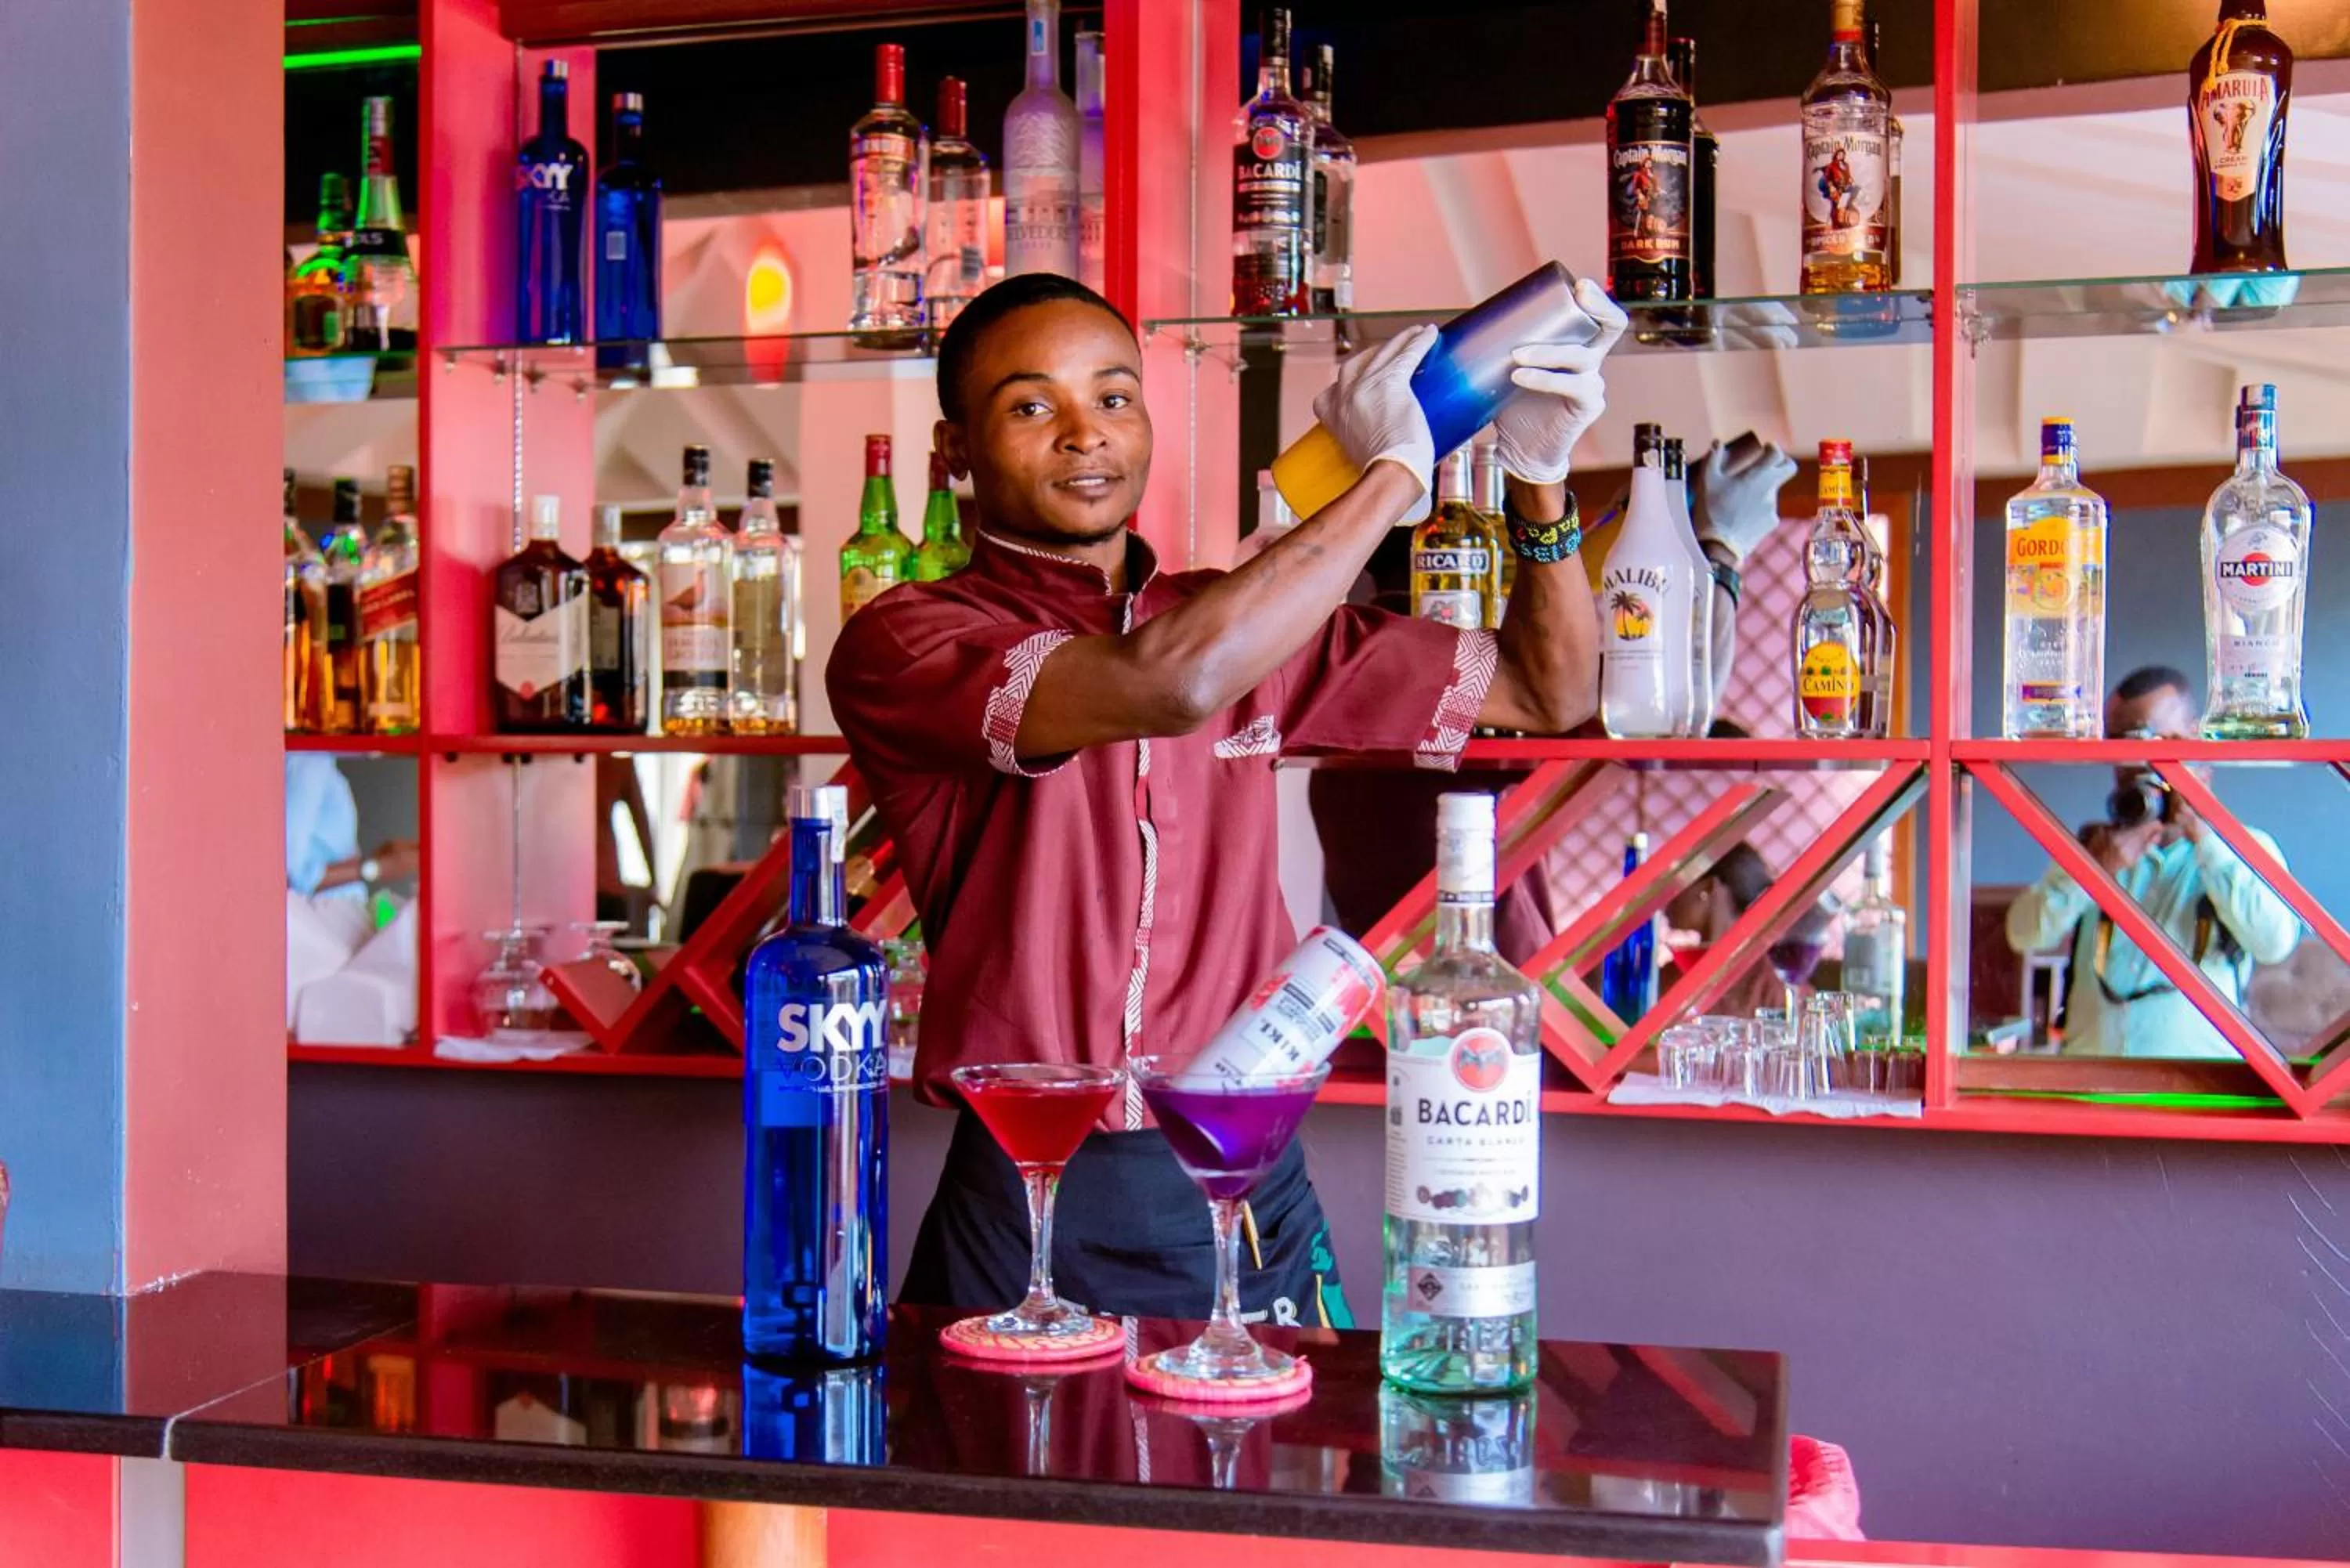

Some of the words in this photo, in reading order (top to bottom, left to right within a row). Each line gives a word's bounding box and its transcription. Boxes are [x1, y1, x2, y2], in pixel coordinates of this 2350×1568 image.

[2200, 78, 2269, 112] AMARULA
[1843, 135, 1882, 156] Morgan
[1621, 238, 1654, 250] DARK
[1655, 237, 1680, 250] RUM
[2222, 563, 2291, 577] MARTINI
[776, 999, 888, 1053] SKYY
[777, 1052, 887, 1082] VODKA
